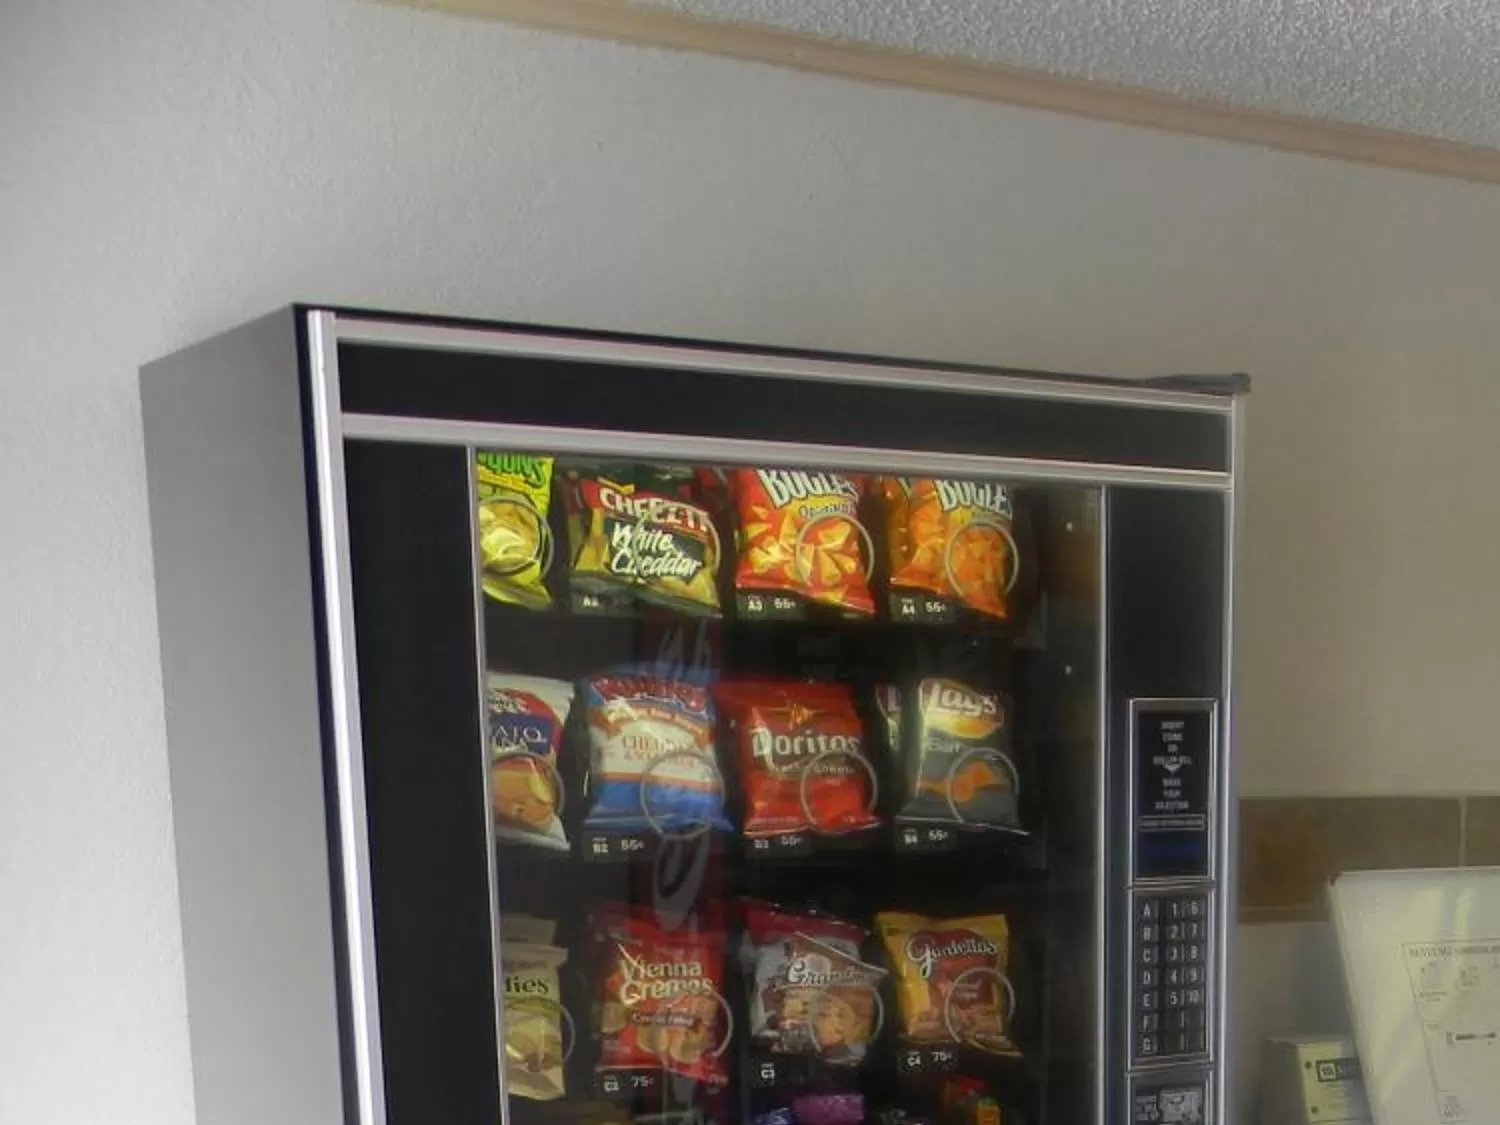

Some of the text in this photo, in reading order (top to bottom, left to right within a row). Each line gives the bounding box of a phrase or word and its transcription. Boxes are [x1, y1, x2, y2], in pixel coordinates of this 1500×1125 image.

[612, 521, 673, 550] White
[611, 551, 702, 578] Cheddar
[752, 730, 860, 758] Doritos
[1143, 903, 1151, 917] A
[1171, 902, 1178, 917] 1
[620, 957, 704, 981] Vienna
